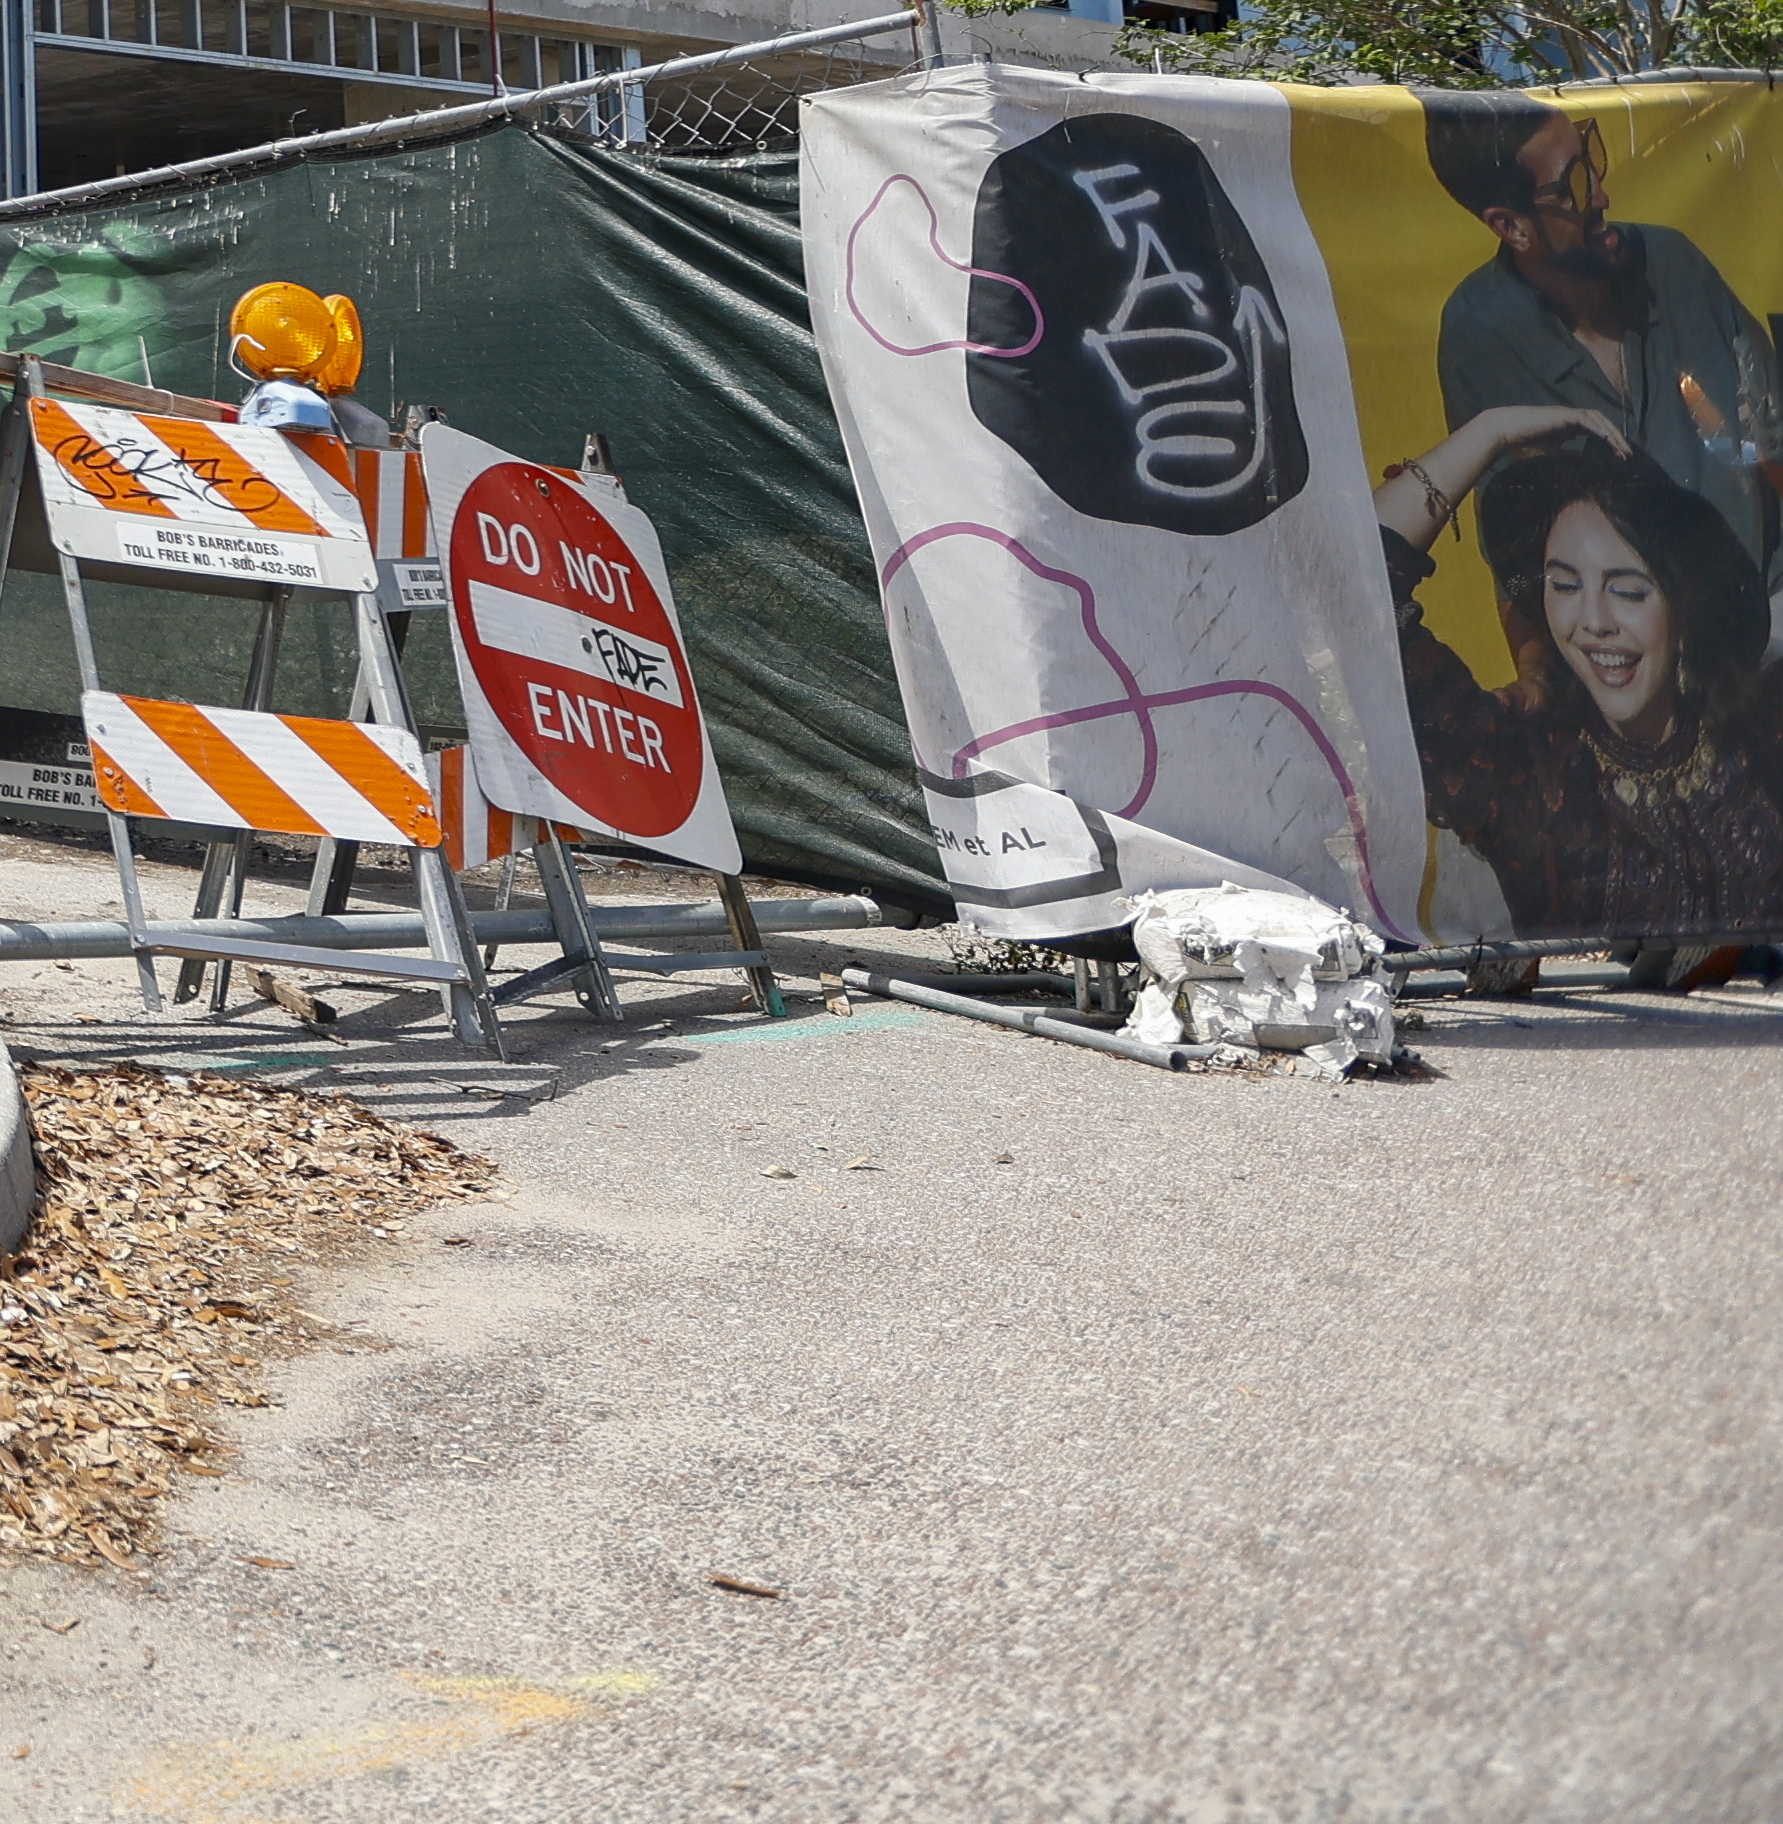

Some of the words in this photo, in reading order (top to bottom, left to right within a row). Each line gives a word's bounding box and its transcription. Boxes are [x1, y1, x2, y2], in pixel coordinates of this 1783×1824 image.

[1072, 163, 1276, 498] FADE
[124, 543, 155, 560] TOLL
[158, 548, 189, 564] FREE
[193, 553, 216, 568] NO.
[219, 557, 318, 579] 1-800-432-5031
[156, 530, 196, 547] BOB'S
[198, 536, 279, 556] BARRICADES
[477, 511, 542, 576] DO
[559, 540, 635, 613] NOT
[592, 627, 668, 692] FADE
[528, 681, 672, 774] ENTER
[33, 769, 72, 786] BOB'S
[27, 787, 60, 804] FREE
[63, 791, 85, 807] NO.
[964, 835, 991, 856] et
[1001, 827, 1047, 854] AL
